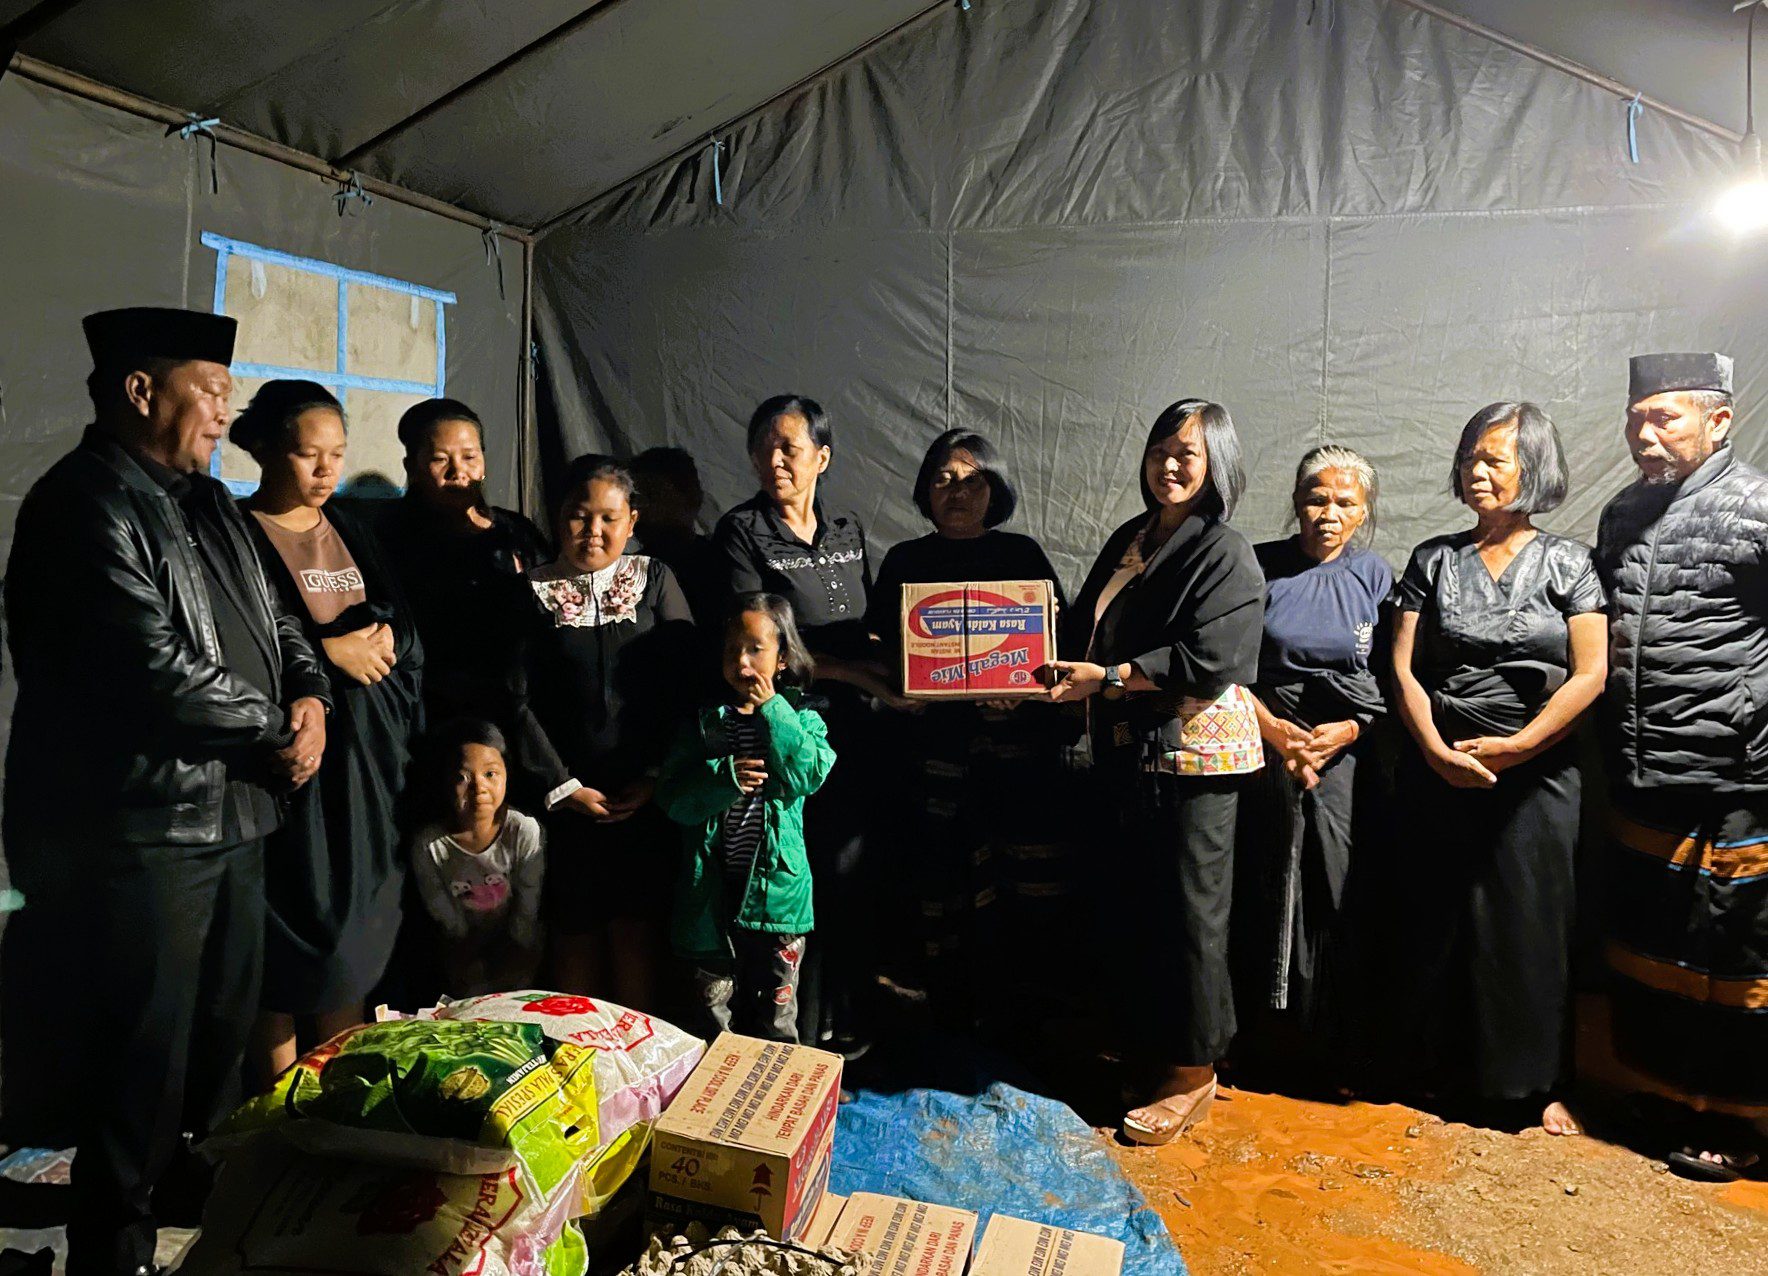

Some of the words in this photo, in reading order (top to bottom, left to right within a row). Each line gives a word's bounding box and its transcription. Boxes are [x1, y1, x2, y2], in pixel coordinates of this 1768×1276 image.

[308, 572, 358, 589] GUESS
[932, 618, 962, 632] Ayam
[1000, 620, 1026, 630] Rasa
[968, 647, 1029, 676] Megah
[931, 663, 966, 683] Mie
[725, 1053, 741, 1068] KEEP
[531, 1070, 556, 1091] PALA
[494, 1084, 536, 1117] SPESIAL
[690, 1096, 712, 1114] PLACE
[766, 1086, 795, 1121] HINDARKAN
[790, 1072, 804, 1087] DARI
[775, 1115, 797, 1139] TEMPAT
[790, 1095, 812, 1117] BASAH
[801, 1082, 818, 1096] DAN
[811, 1063, 829, 1084] PANAS
[671, 1157, 700, 1177] 40
[860, 1215, 875, 1229] KEEP
[948, 1221, 965, 1241] PANAS
[926, 1231, 942, 1246] DARI
[943, 1241, 958, 1255] DAN
